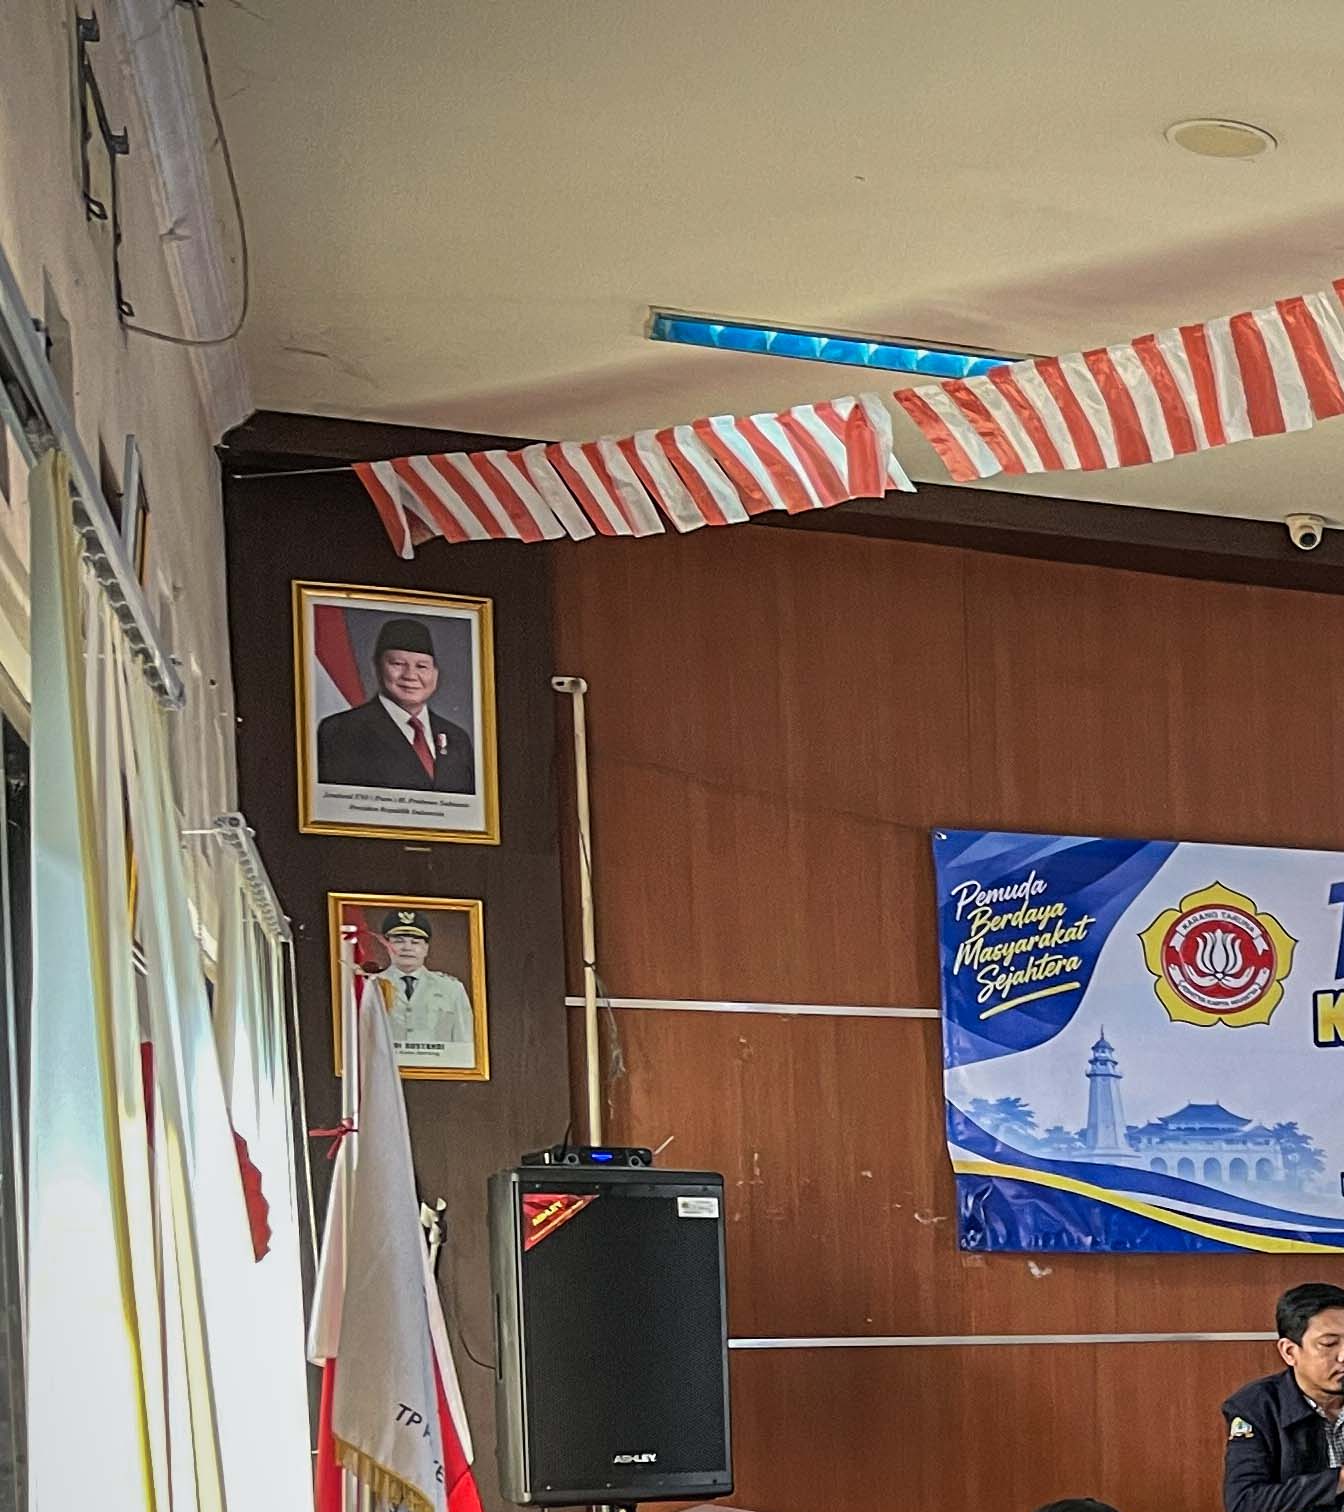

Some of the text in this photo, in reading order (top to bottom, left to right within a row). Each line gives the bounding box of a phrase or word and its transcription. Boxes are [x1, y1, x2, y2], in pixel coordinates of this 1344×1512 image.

[951, 870, 1048, 921] Pemuda
[953, 915, 1096, 975] Masyarakat
[966, 901, 1067, 943] Berdaya
[977, 953, 1082, 1003] Sejahtera
